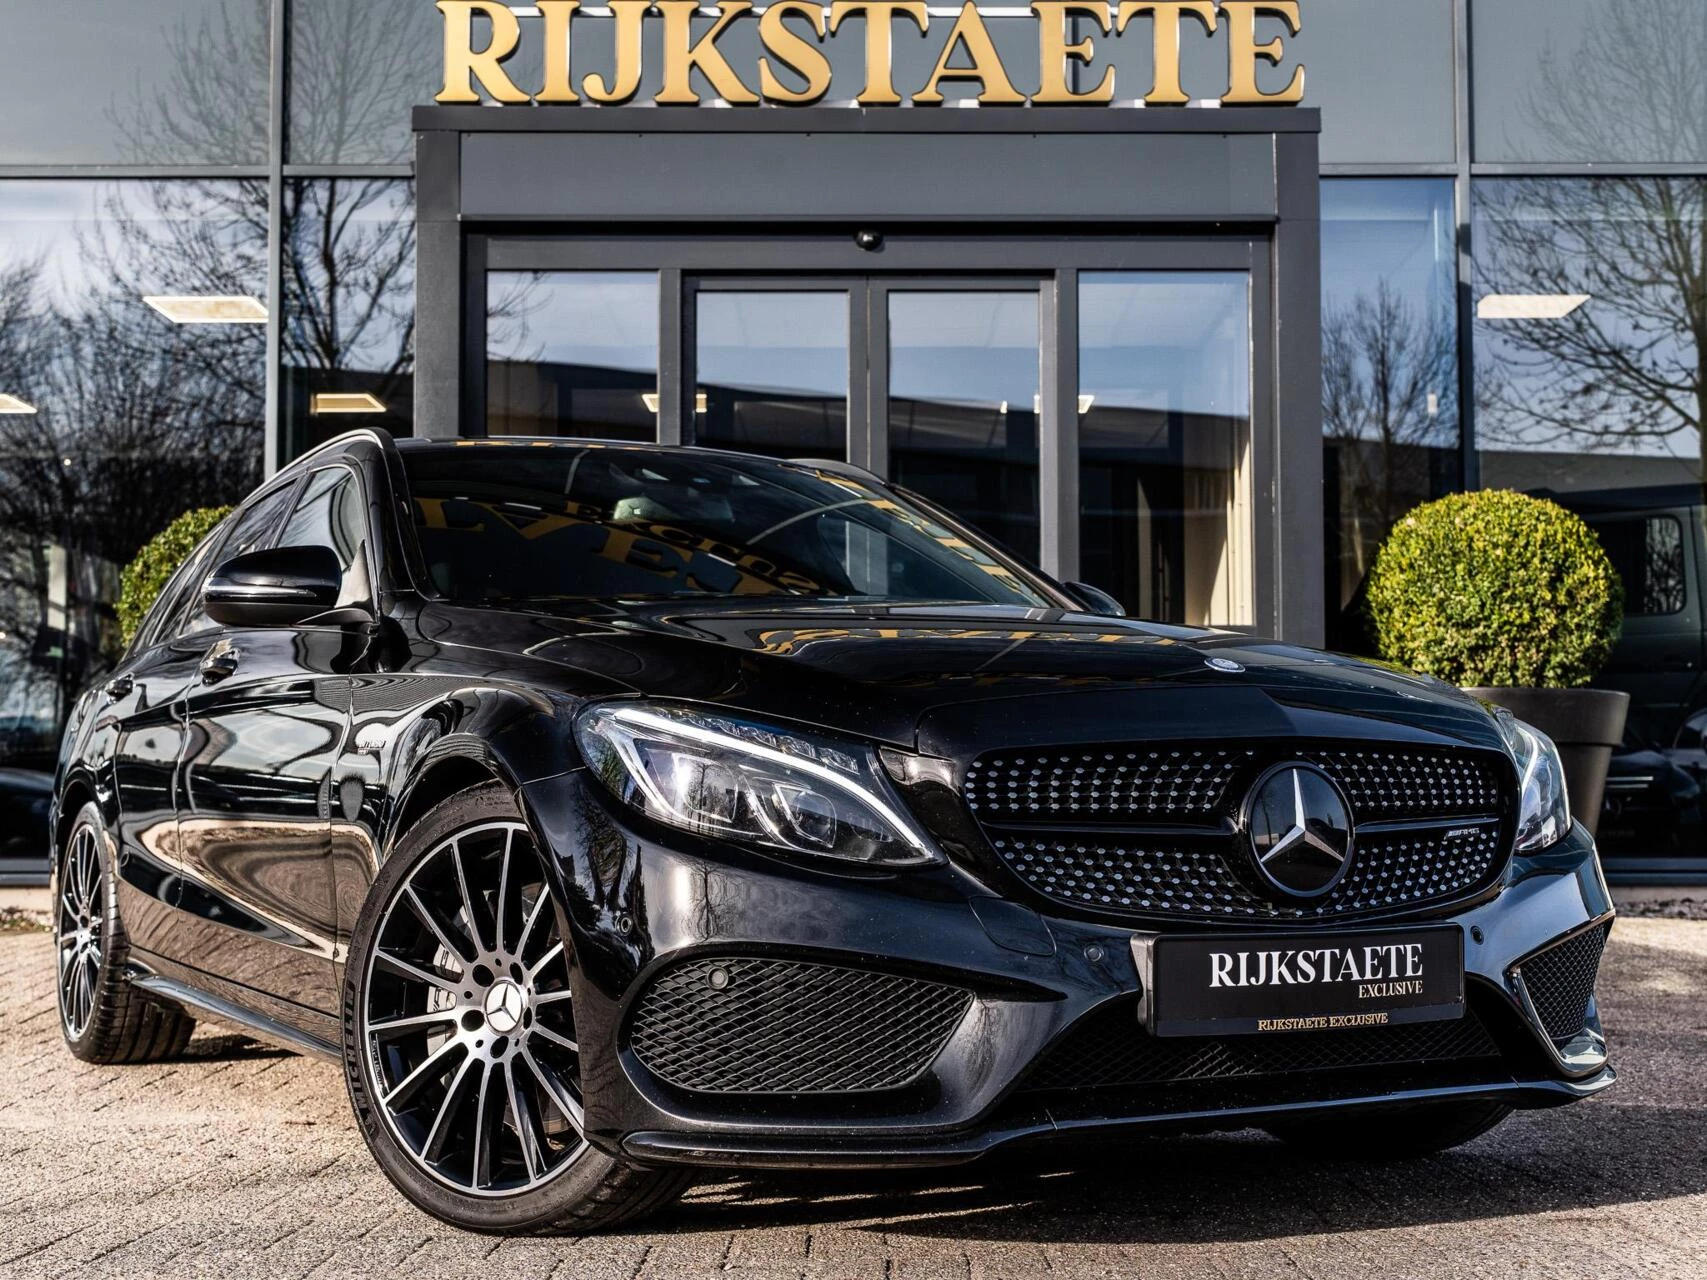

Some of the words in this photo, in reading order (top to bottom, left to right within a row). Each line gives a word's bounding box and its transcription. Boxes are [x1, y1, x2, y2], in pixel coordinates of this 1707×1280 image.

[434, 0, 1304, 106] RIJKSTAETE
[1209, 943, 1423, 988] RIJKSTAETE
[1358, 980, 1423, 999] EXCLUSIVE
[1258, 1016, 1328, 1031] RIJKSTAETE
[1329, 1012, 1389, 1027] EXCLUSIVE
[345, 987, 367, 1109] MICHELIN
